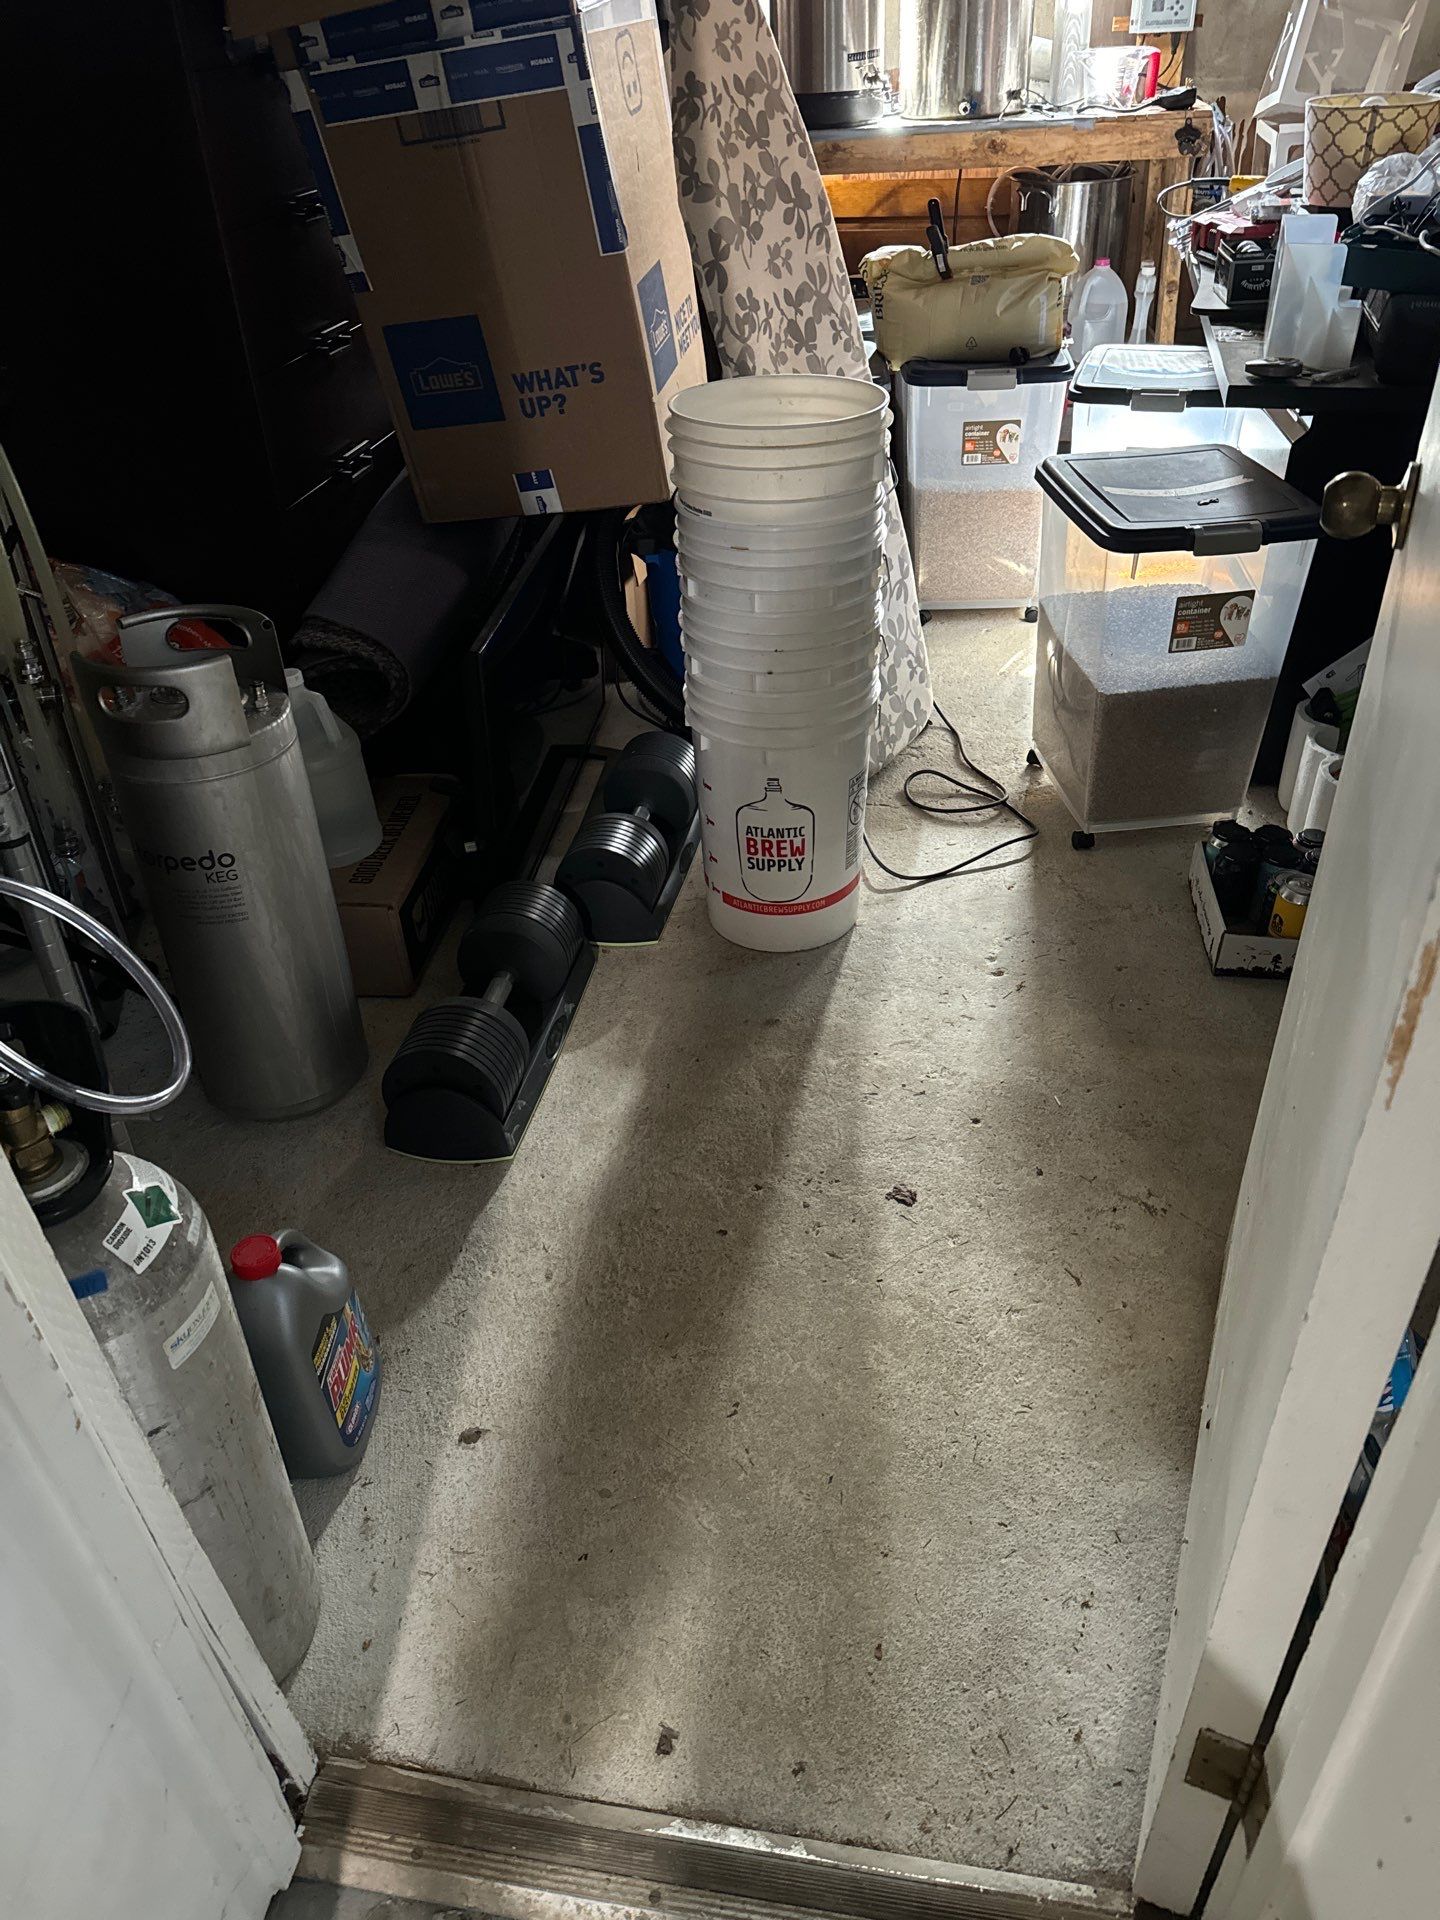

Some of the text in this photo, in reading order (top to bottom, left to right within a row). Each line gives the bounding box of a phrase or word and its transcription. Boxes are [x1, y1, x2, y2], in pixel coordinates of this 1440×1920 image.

[418, 369, 475, 391] LOWE'S
[511, 362, 605, 394] WHAT'S
[518, 394, 567, 419] UP?
[964, 424, 984, 432] airtight
[1177, 607, 1212, 616] container
[745, 824, 806, 838] ATLANTIC
[745, 836, 807, 858] BREW
[141, 849, 235, 875] orpedo
[747, 856, 806, 872] SUPPLY
[205, 869, 238, 884] KEG
[732, 898, 826, 914] ATLANTICBREWSUPPLY.COM
[105, 1221, 127, 1245] CARBON
[112, 1227, 133, 1250] DIOXIDE
[133, 1238, 157, 1266] UN1013
